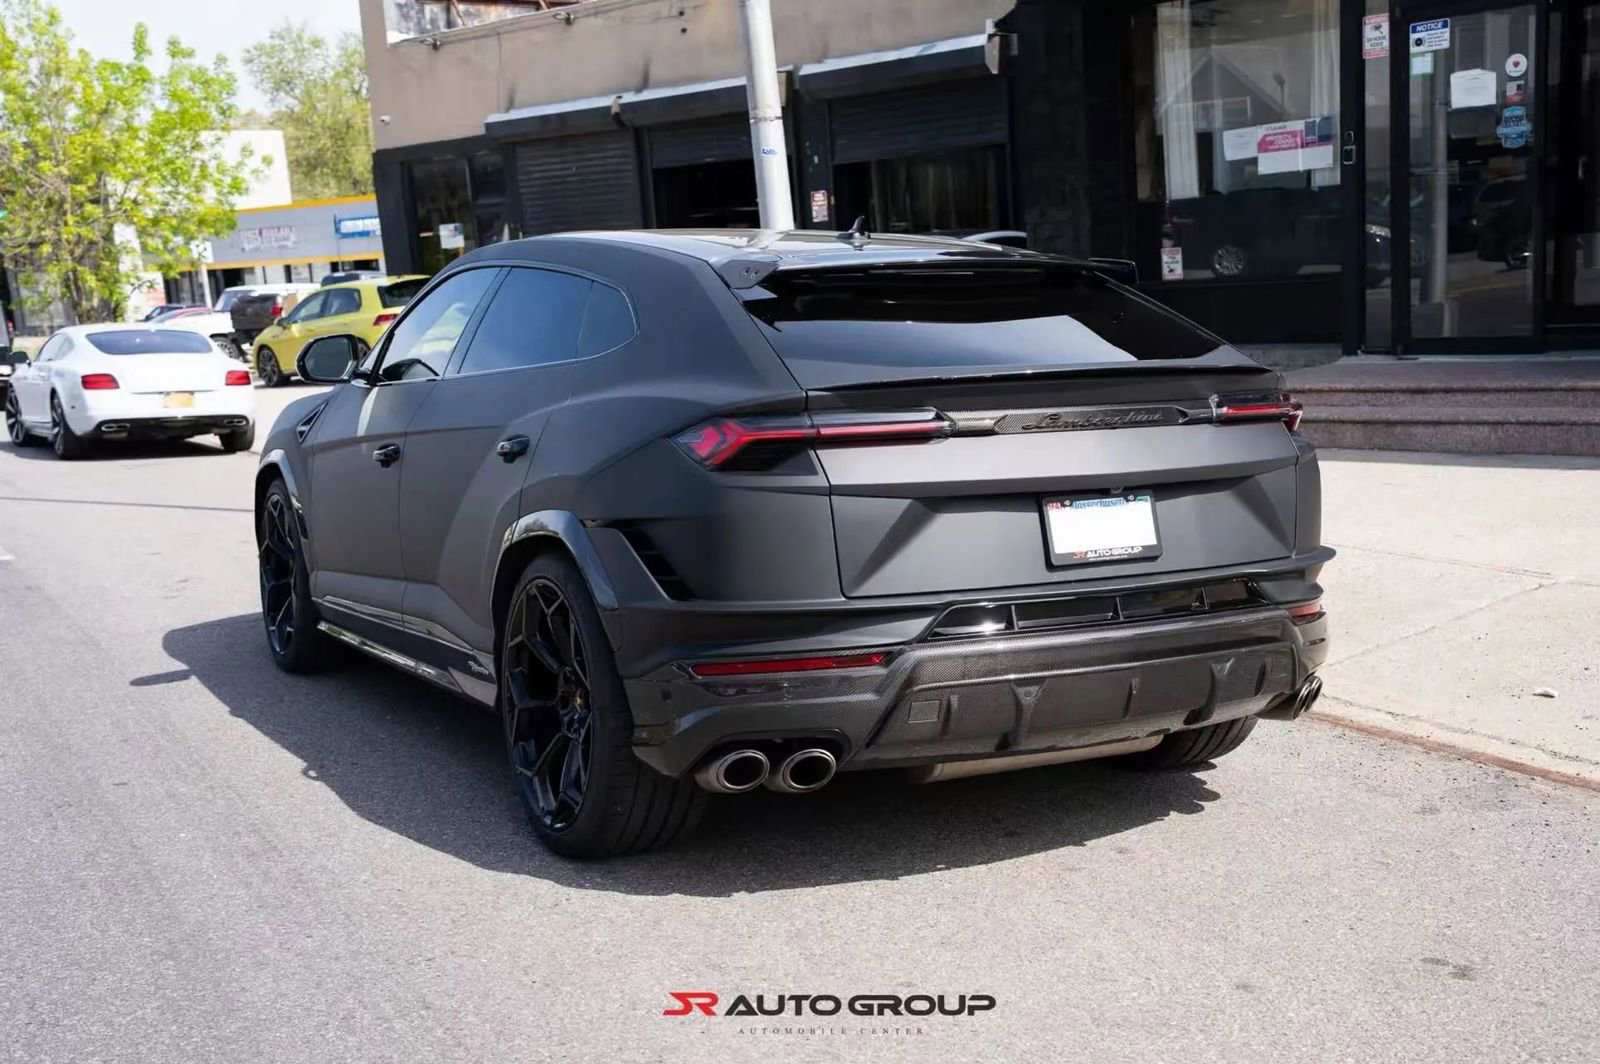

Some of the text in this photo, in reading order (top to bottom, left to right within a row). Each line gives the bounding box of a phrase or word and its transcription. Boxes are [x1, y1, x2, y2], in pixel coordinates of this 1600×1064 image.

[1416, 21, 1444, 32] NOTICE
[1021, 411, 1163, 430] Lamborghini
[1086, 549, 1111, 558] AUTO
[1111, 546, 1143, 556] GROUP
